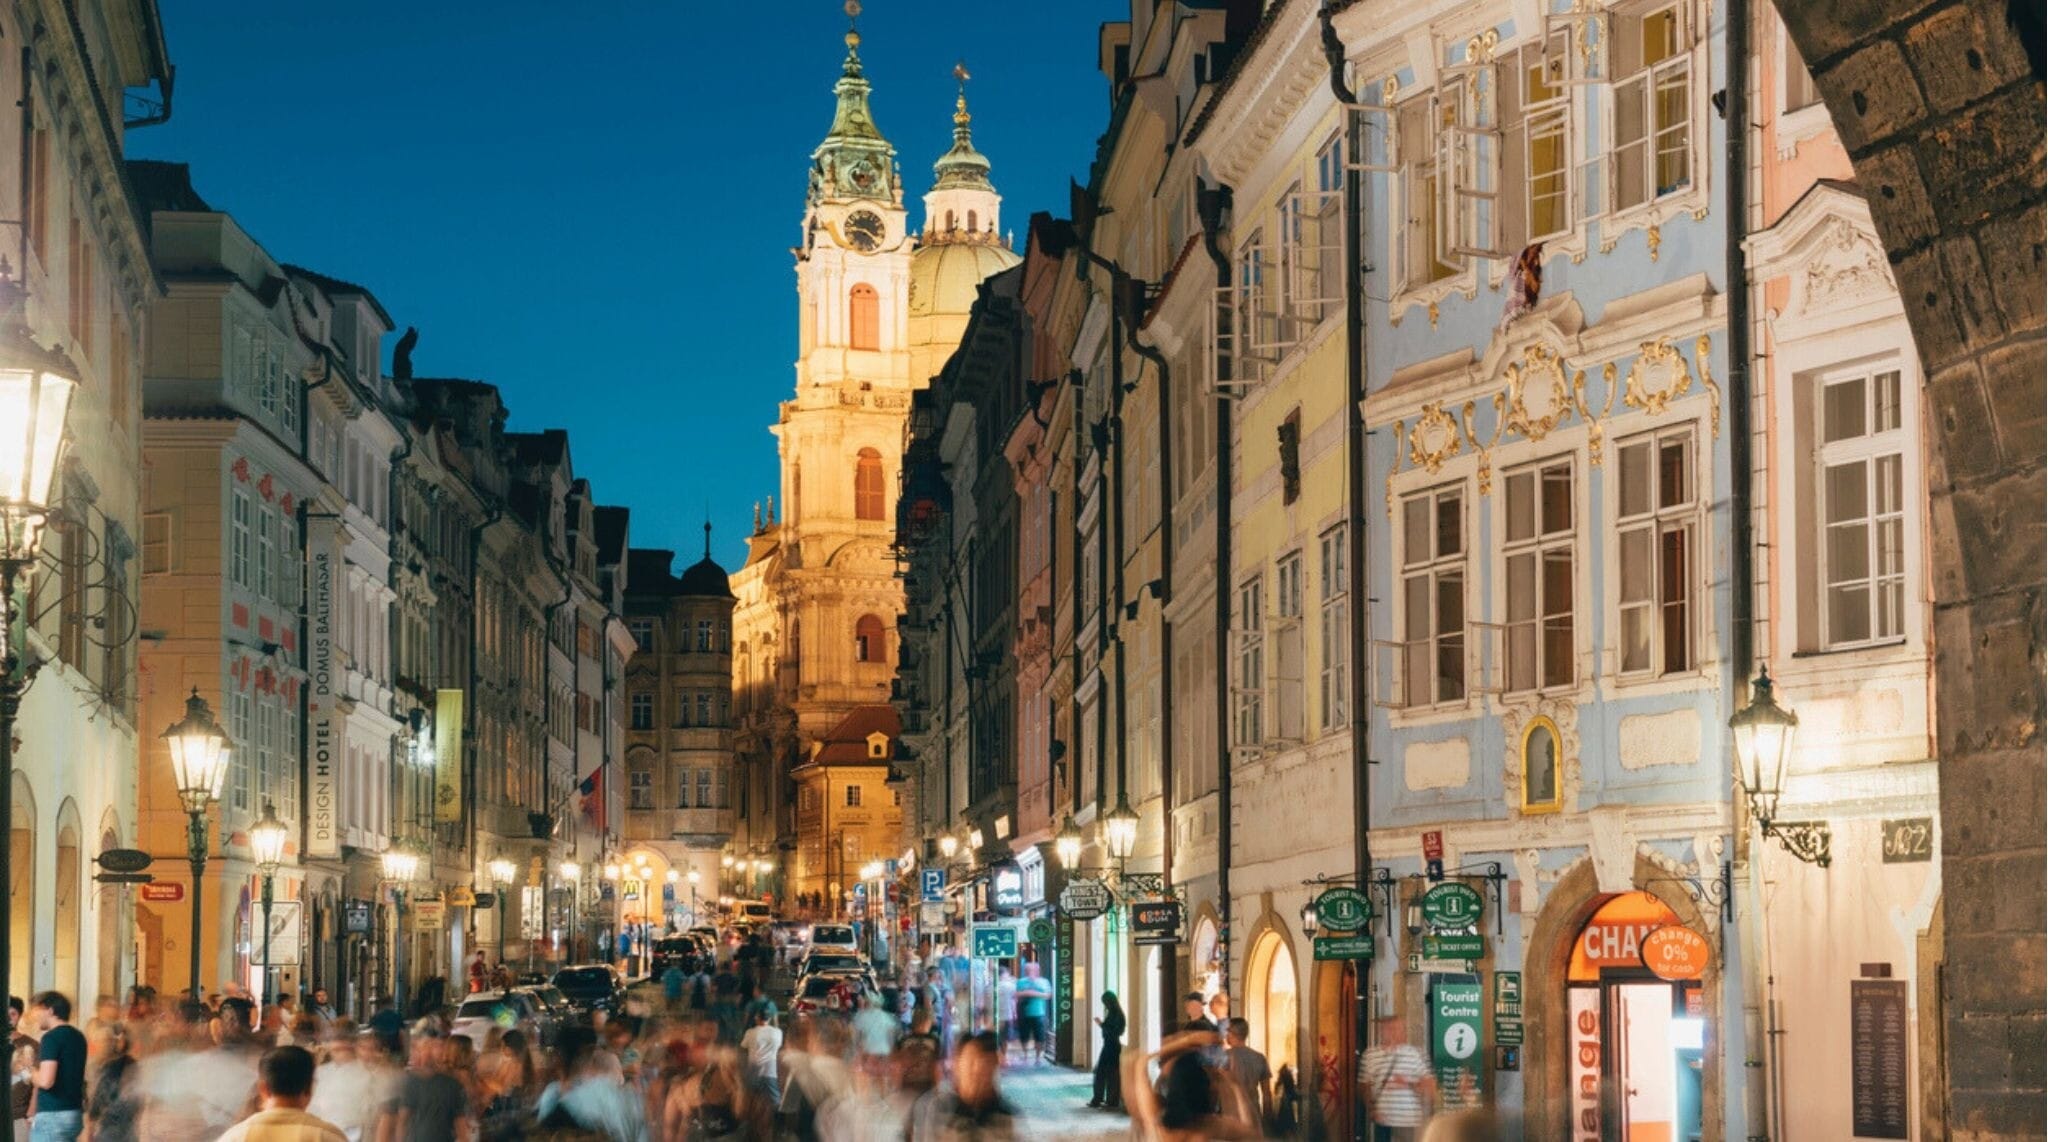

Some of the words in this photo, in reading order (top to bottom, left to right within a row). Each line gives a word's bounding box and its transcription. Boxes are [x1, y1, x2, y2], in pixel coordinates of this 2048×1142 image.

[316, 637, 330, 696] DOMUS
[316, 718, 330, 776] HOTEL
[316, 782, 330, 841] DESIGN
[926, 872, 940, 892] P
[1320, 889, 1350, 904] TOURIST
[1350, 890, 1368, 904] INFO
[1428, 885, 1459, 901] TOURIST
[1459, 886, 1477, 901] INFO
[1440, 943, 1460, 952] TICKET
[1461, 943, 1481, 952] OFFICE
[1651, 929, 1701, 948] change
[1663, 943, 1689, 961] 0%
[1060, 974, 1072, 1023] SHOP
[1440, 990, 1480, 1003] Tourist
[1440, 1005, 1479, 1017] Centre
[1577, 1009, 1602, 1142] ange
